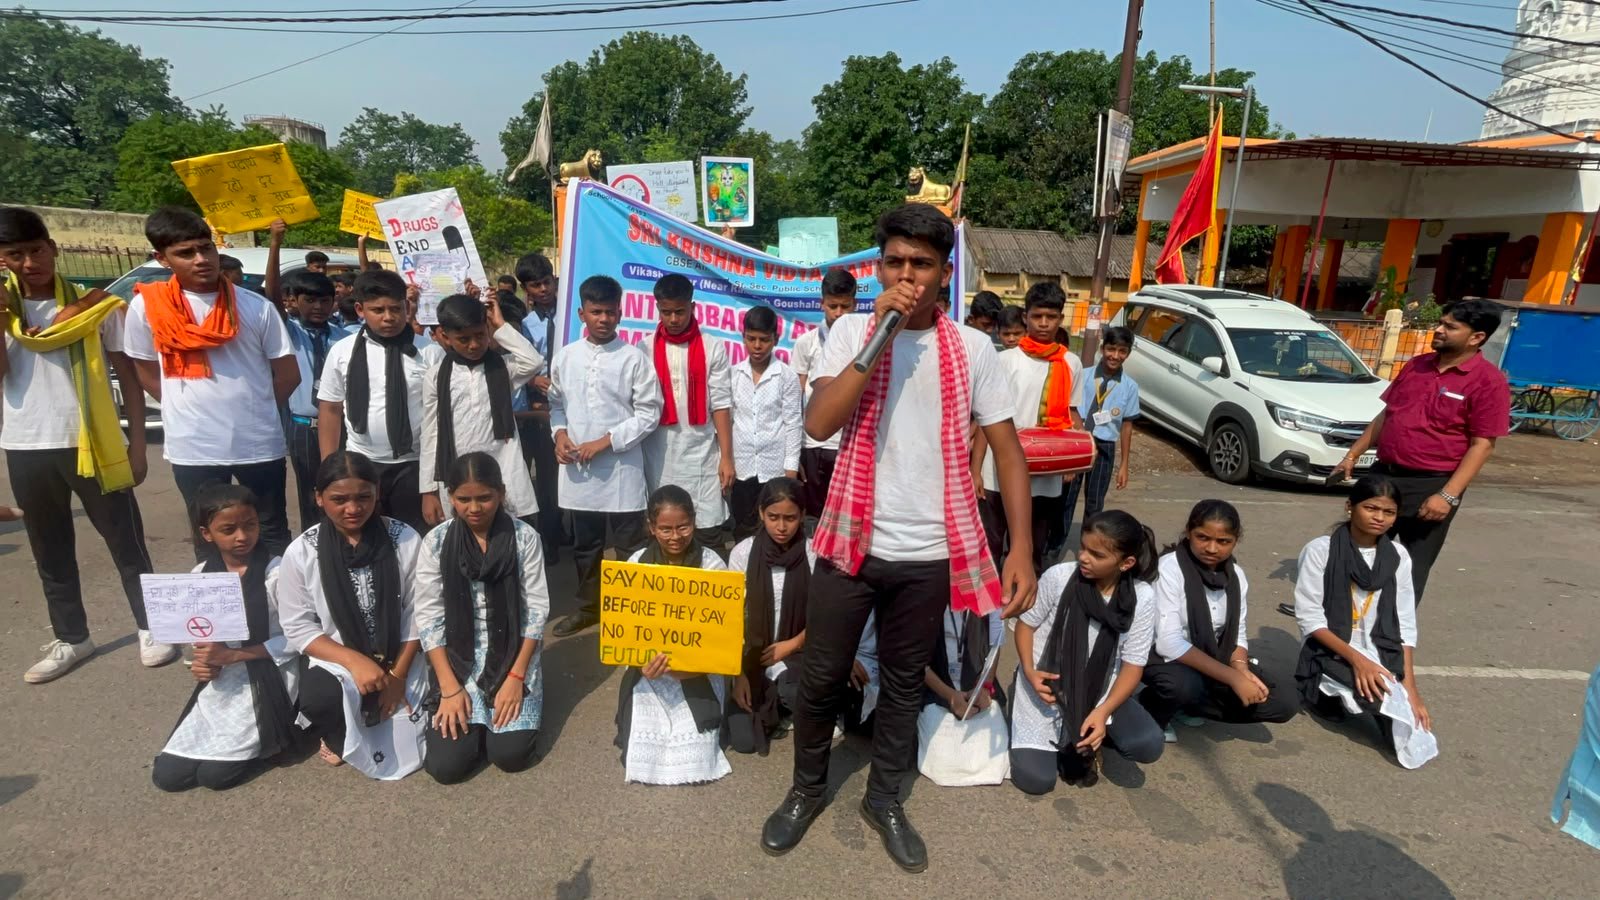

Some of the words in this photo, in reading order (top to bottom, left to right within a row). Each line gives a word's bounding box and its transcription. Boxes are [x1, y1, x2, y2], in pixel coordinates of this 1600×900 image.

[387, 216, 439, 237] DRUGS
[395, 239, 430, 255] END
[628, 213, 662, 247] SRI
[666, 231, 756, 278] KRISHNA
[665, 256, 693, 268] CBSE
[699, 279, 728, 291] (Near
[772, 284, 801, 292] Public
[603, 568, 637, 588] SAY
[642, 574, 665, 592] NO
[668, 576, 686, 594] TO
[688, 580, 742, 601] DRUGS
[602, 596, 657, 617] BEFORE
[662, 602, 697, 622] THEY
[699, 608, 727, 626] SAY
[601, 623, 625, 639] NO
[634, 625, 653, 642] TO
[659, 628, 703, 648] YOUR
